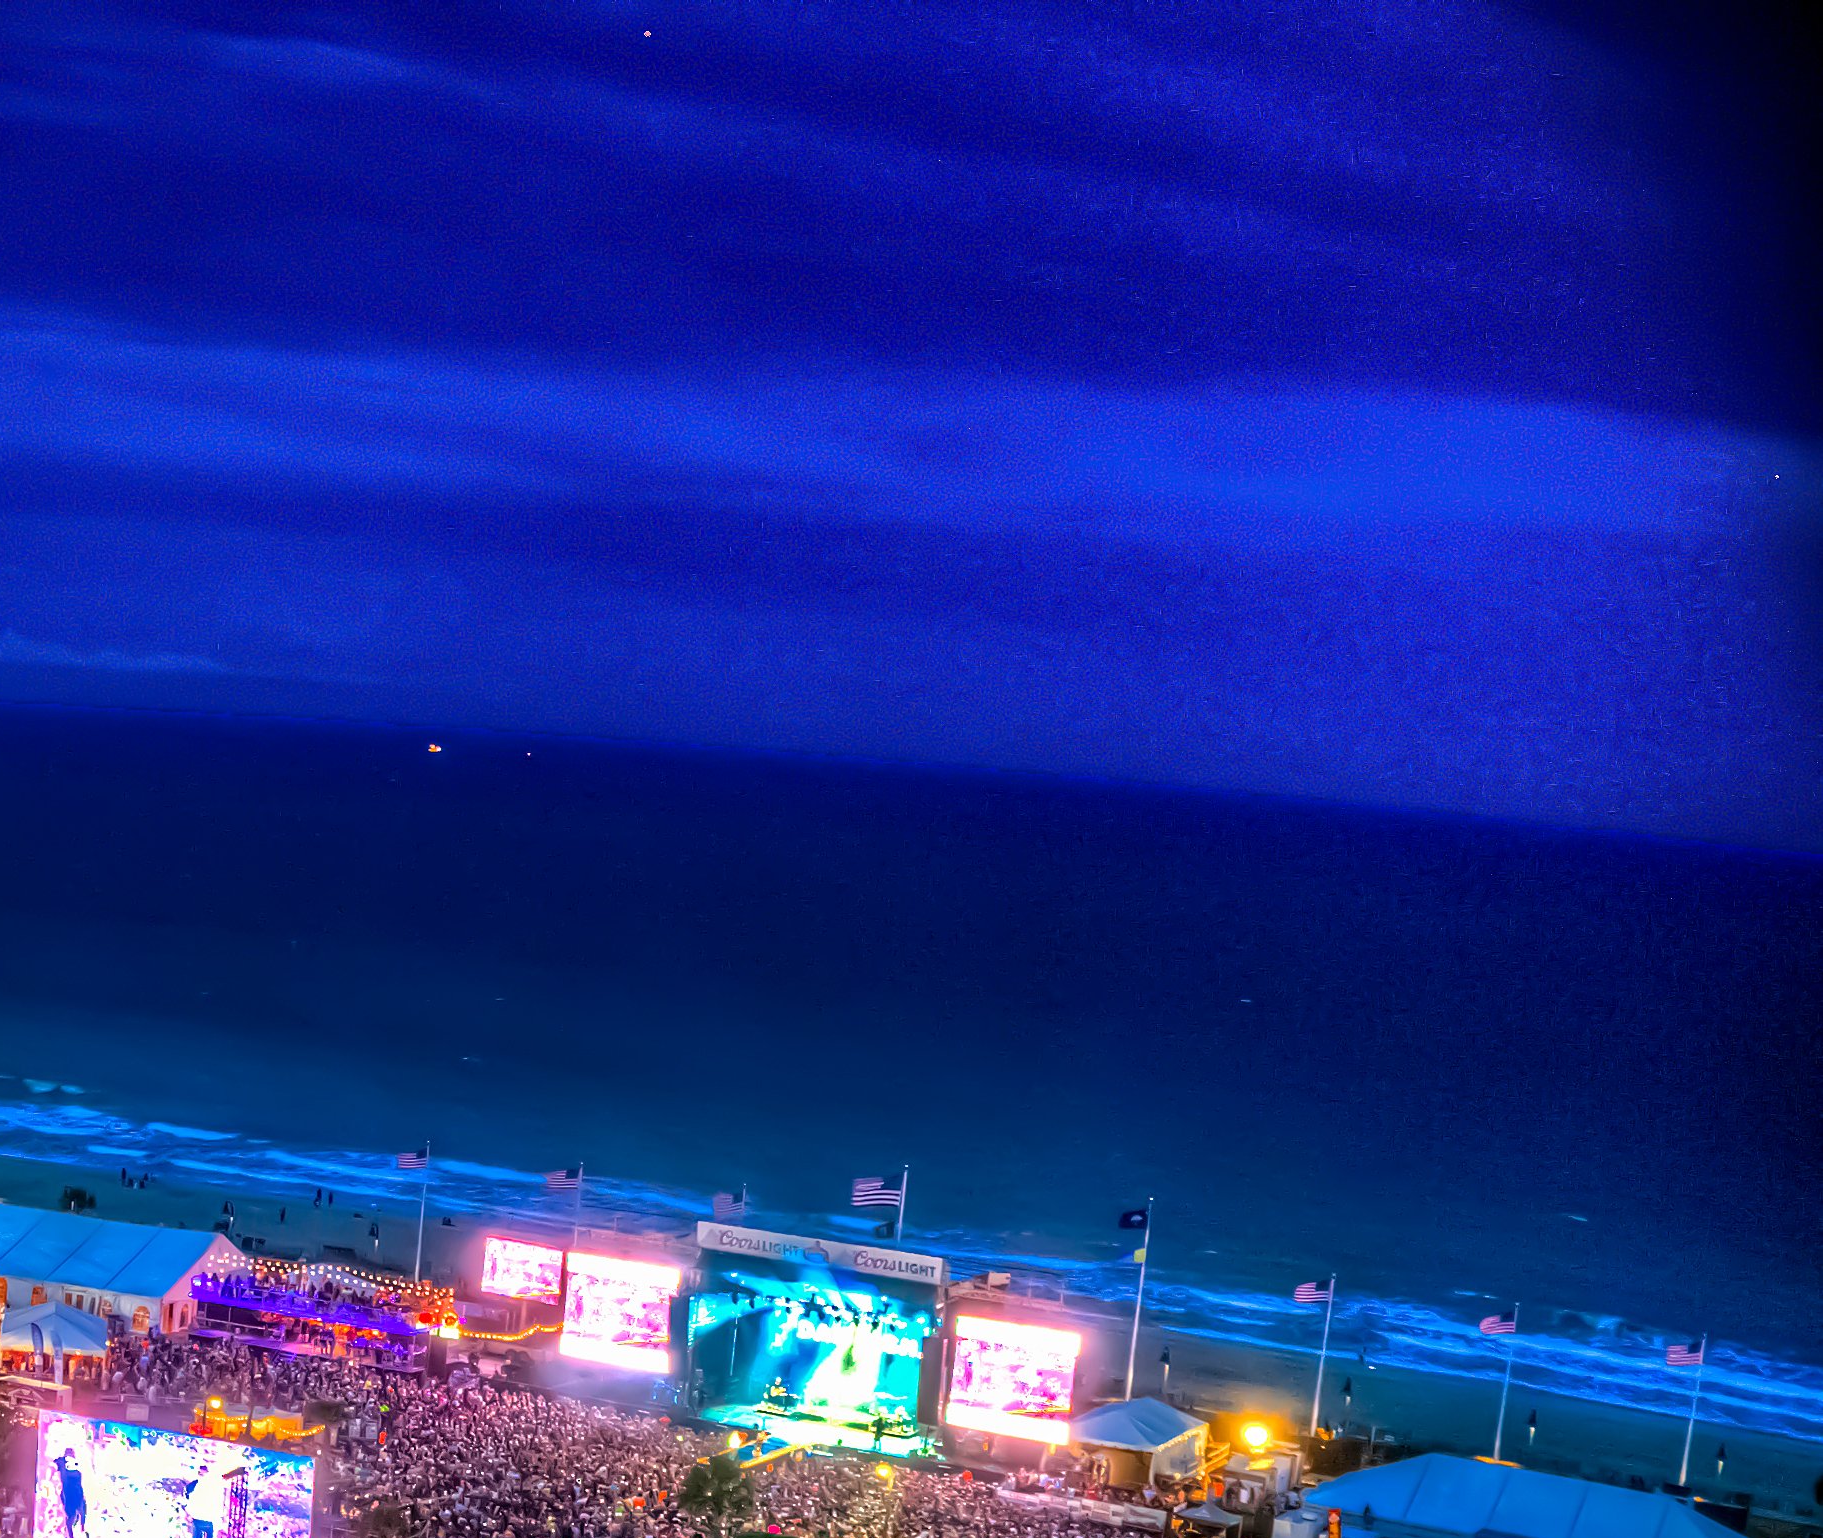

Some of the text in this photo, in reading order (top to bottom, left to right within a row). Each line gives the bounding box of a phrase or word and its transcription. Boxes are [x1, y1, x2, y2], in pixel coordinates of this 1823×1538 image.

[718, 1230, 761, 1251] Coors
[855, 1250, 937, 1278] Coors LIGHT
